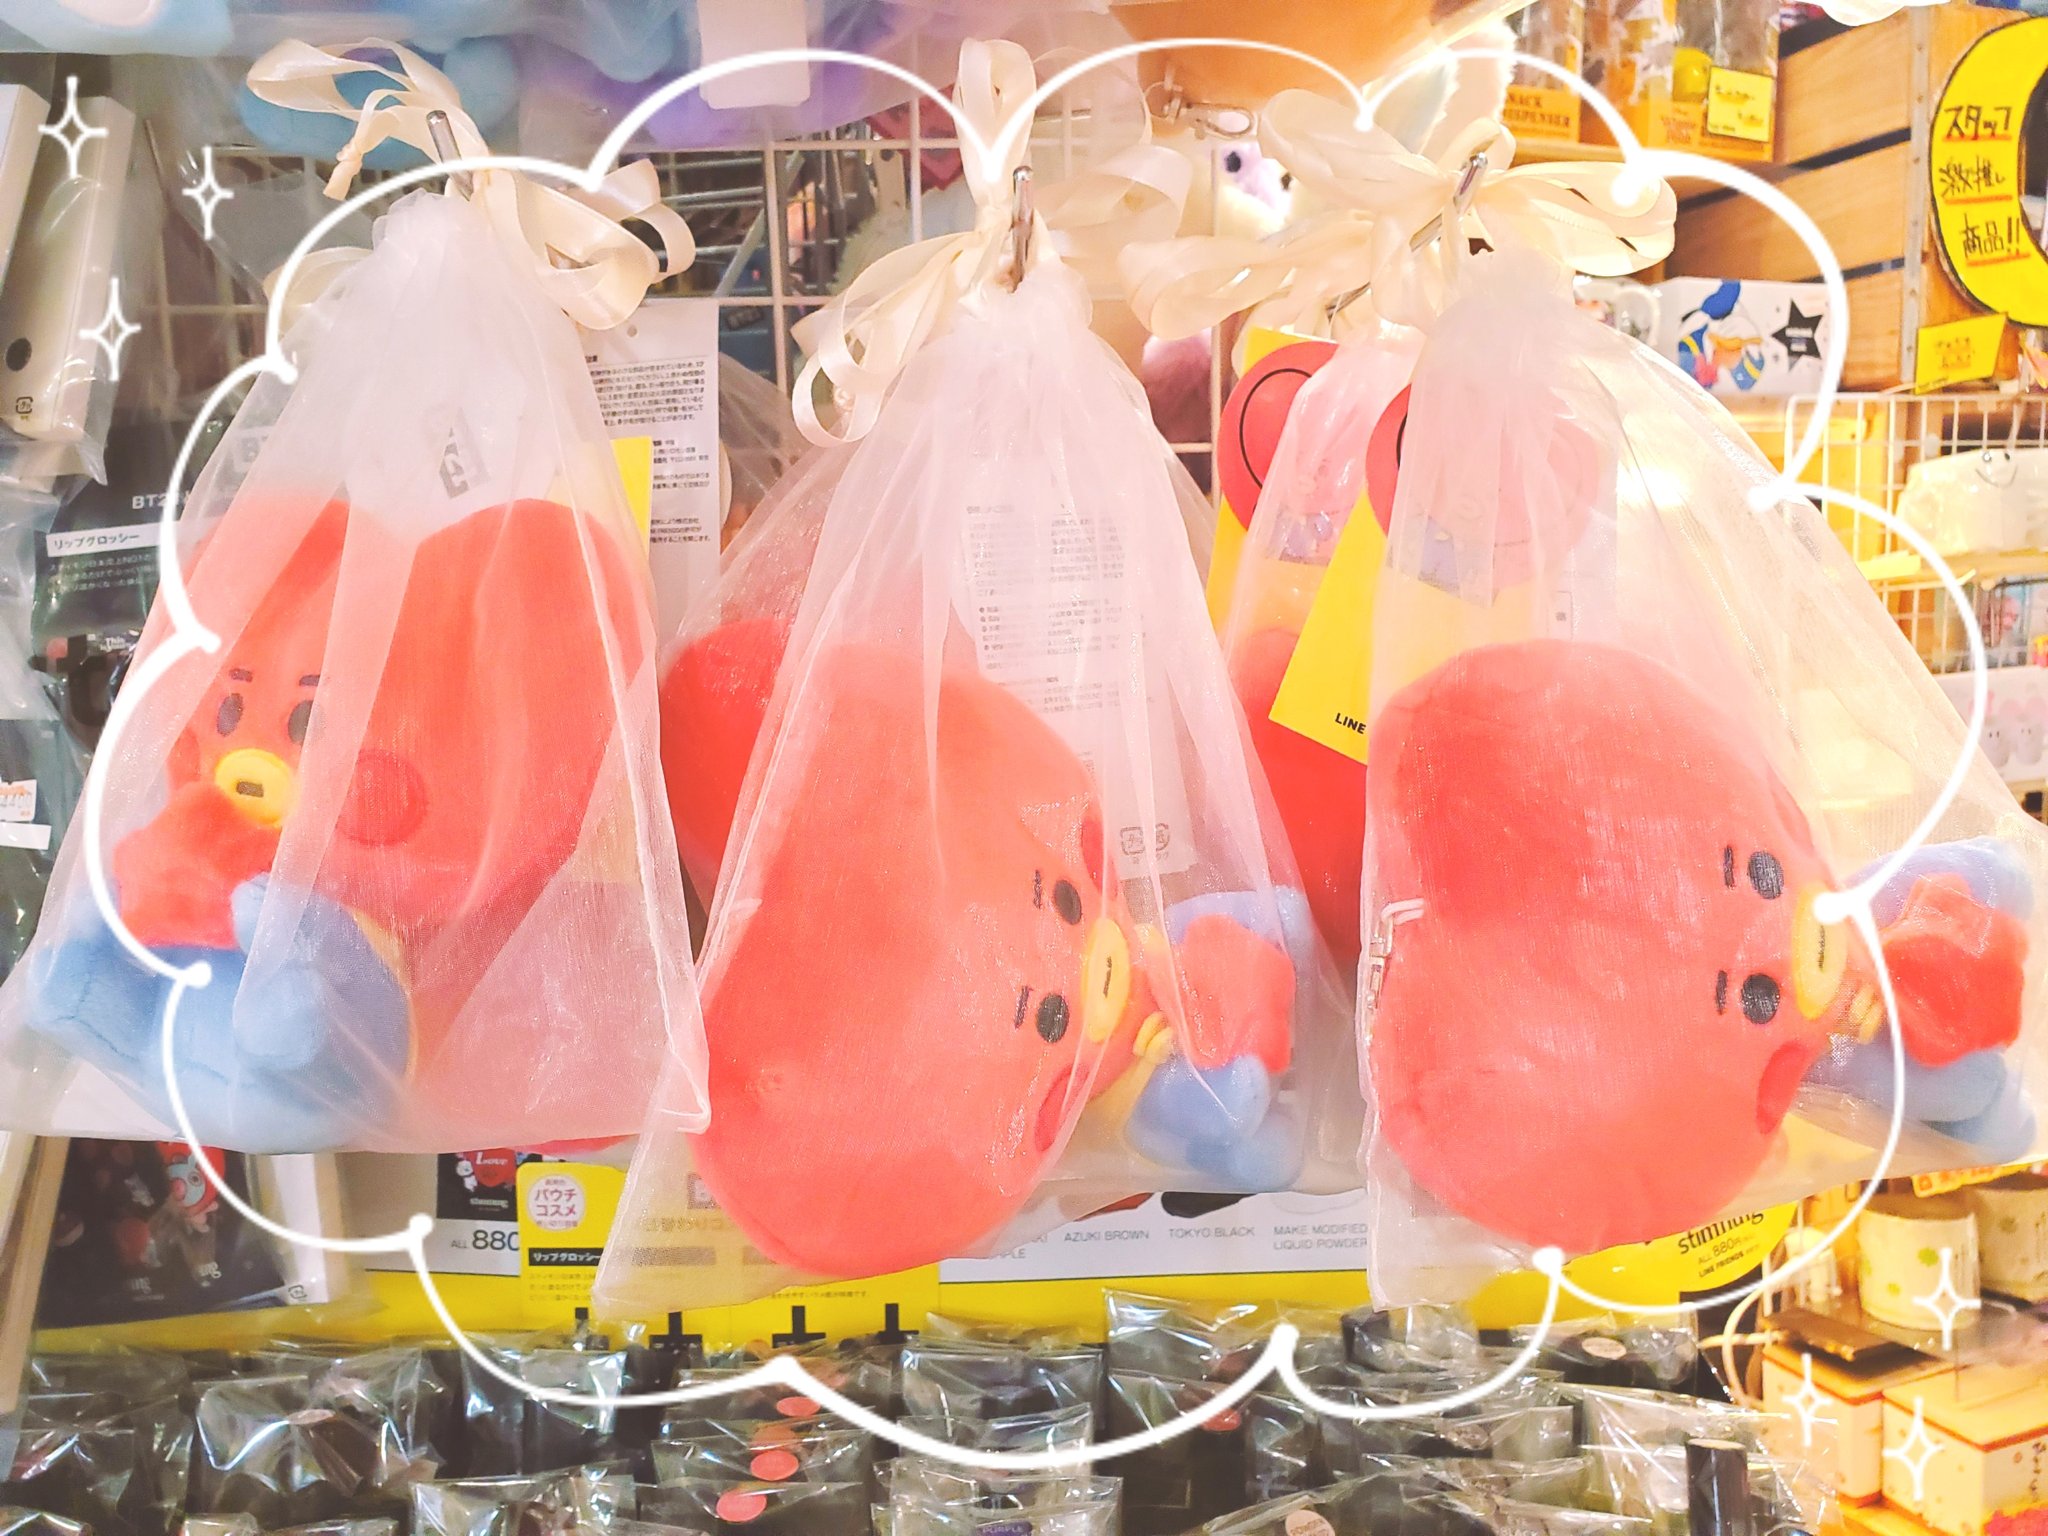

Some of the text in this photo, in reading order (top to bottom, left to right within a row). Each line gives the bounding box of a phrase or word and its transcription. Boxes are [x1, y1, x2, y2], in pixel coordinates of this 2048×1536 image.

[1943, 104, 2013, 140] スタッフ
[53, 533, 140, 550] リップグロッシー
[1335, 712, 1367, 735] LINE
[534, 1188, 577, 1202] パウチ
[536, 1203, 576, 1217] コスメ
[1064, 1229, 1150, 1242] AZUKI BROWN
[1169, 1226, 1256, 1239] TOKYO BLACK
[1273, 1223, 1369, 1235] MAKE MODIFIED
[472, 1229, 519, 1251] 880
[1273, 1237, 1368, 1250] LIQUID POWDER
